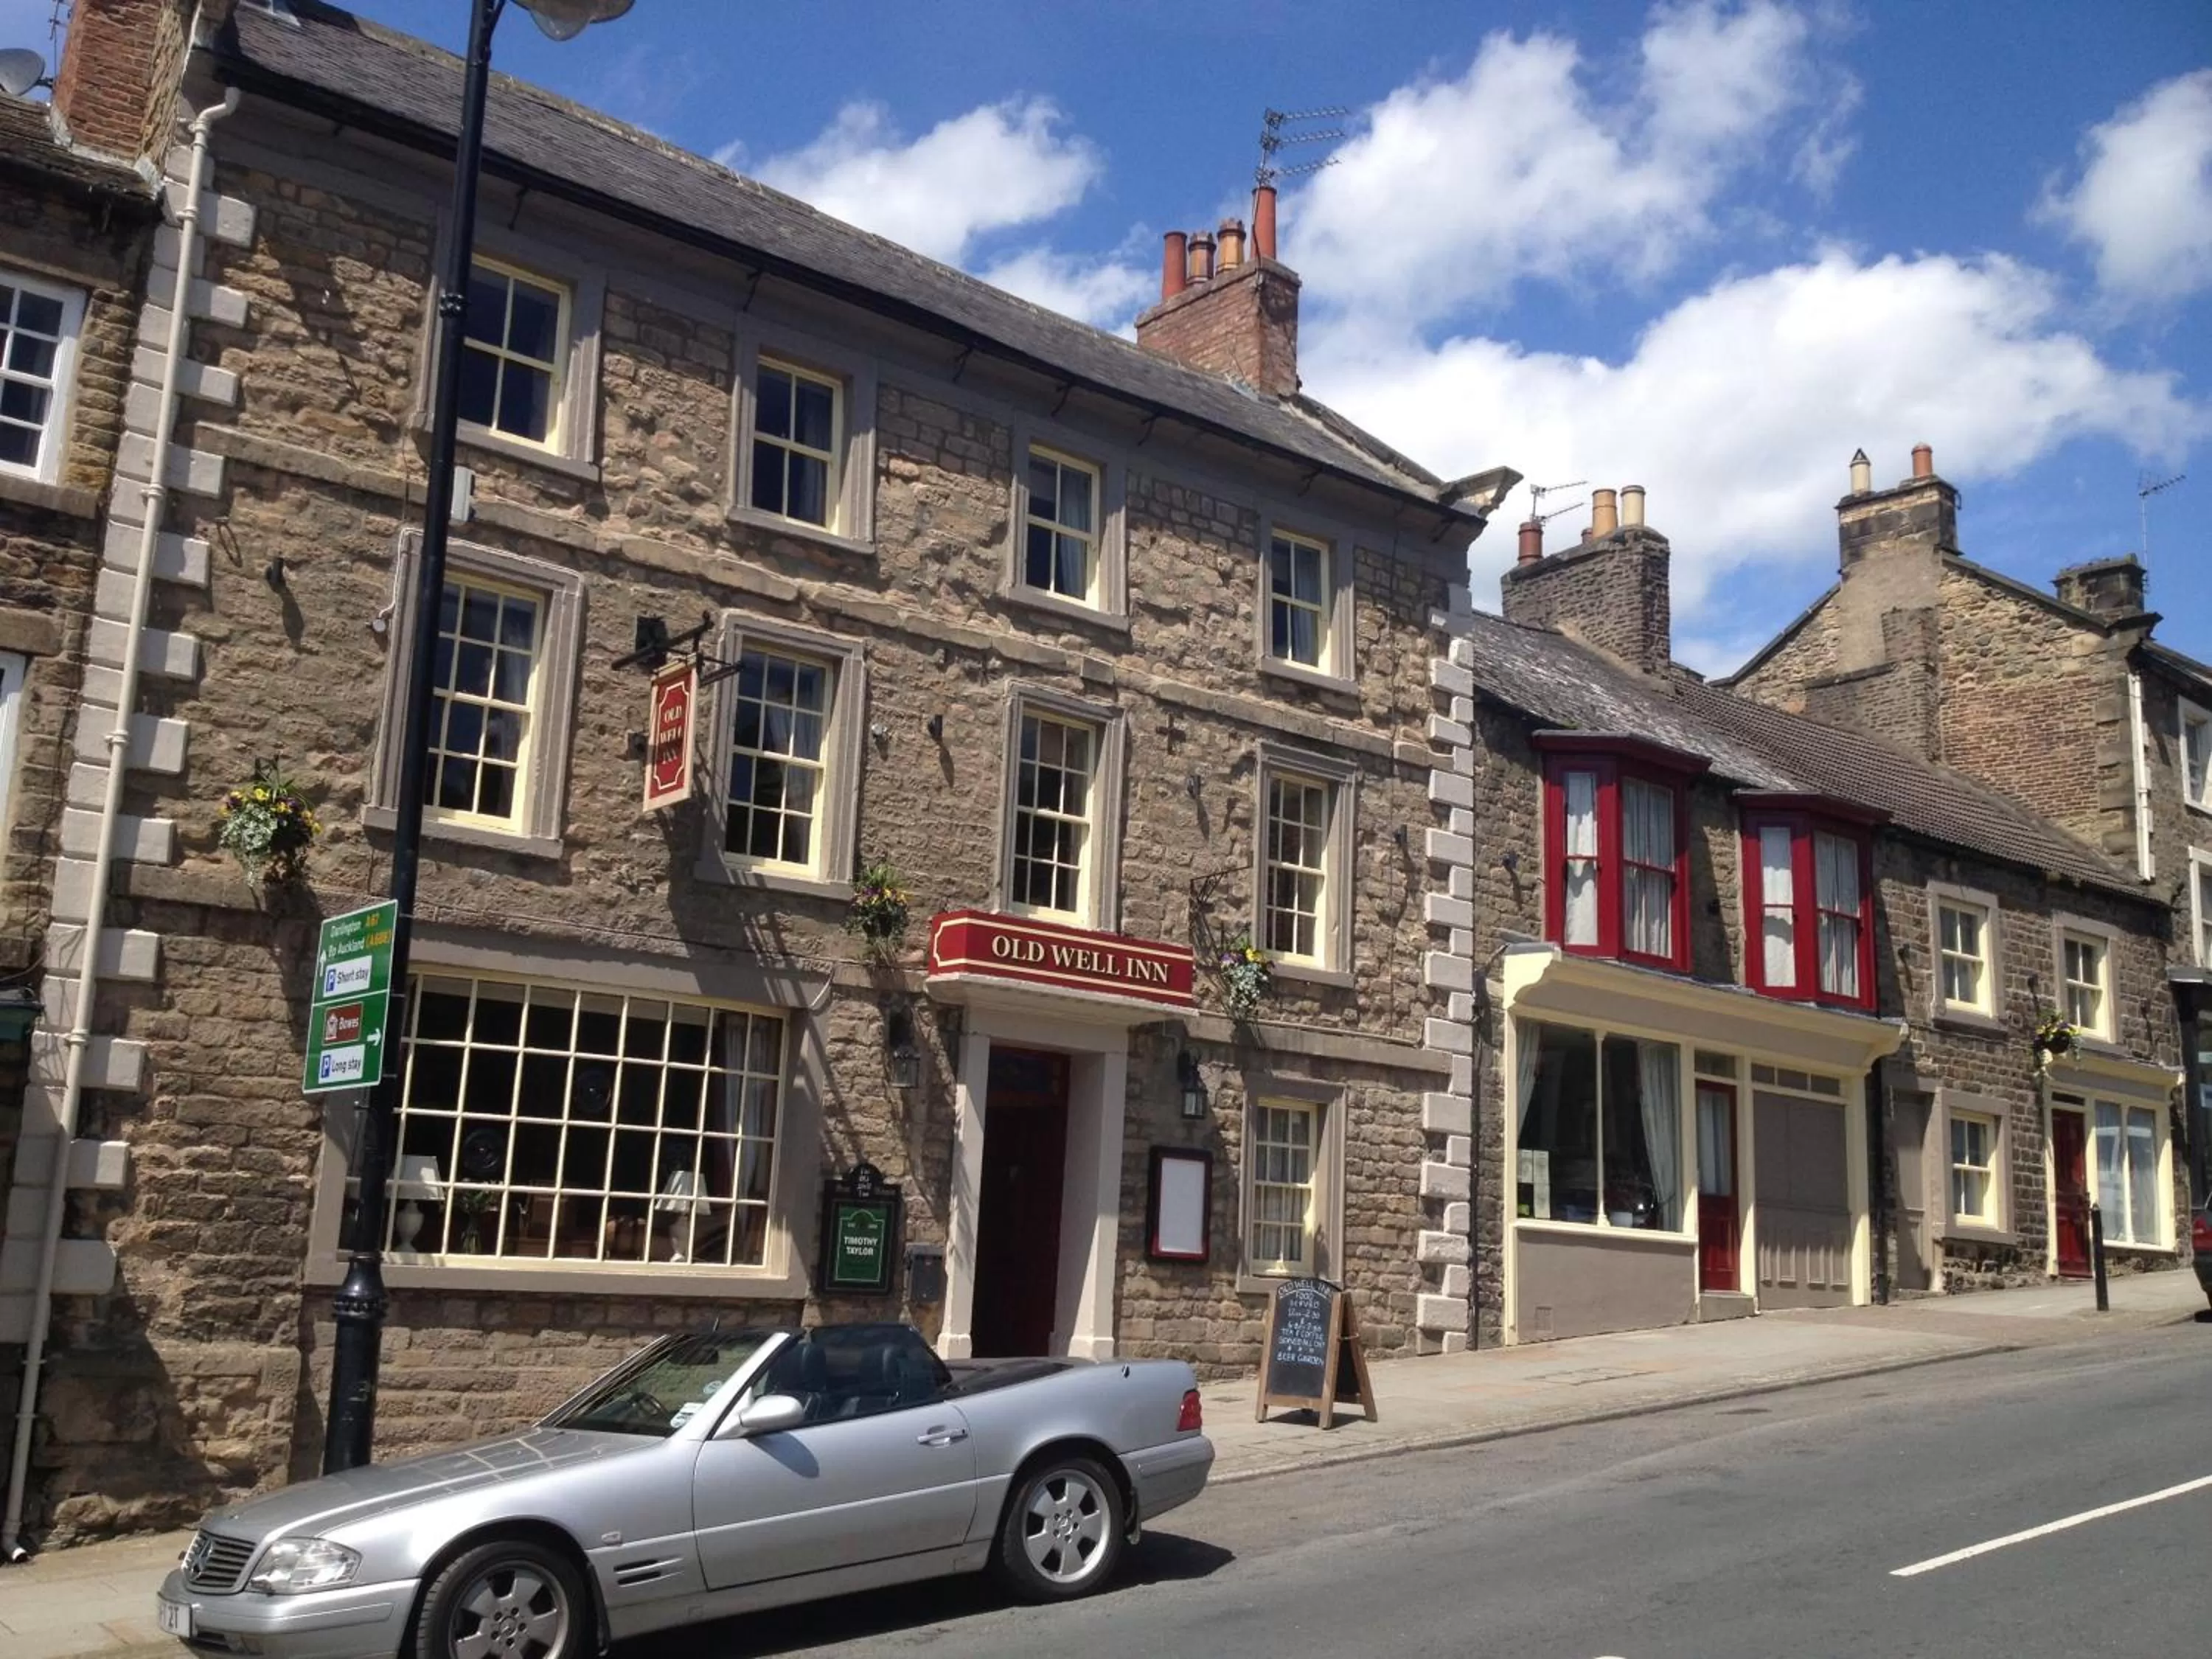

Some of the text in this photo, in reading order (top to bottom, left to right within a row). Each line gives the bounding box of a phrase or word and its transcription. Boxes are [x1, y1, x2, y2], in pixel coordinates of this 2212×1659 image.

[664, 705, 682, 723] OLD
[330, 920, 362, 938] Darlington
[337, 936, 365, 953] Auckland
[992, 934, 1169, 984] OLD WELL INN
[337, 968, 355, 984] Short
[355, 967, 369, 981] stay
[339, 1017, 360, 1030] Bowes
[332, 1060, 347, 1074] Long
[348, 1057, 361, 1071] stay
[844, 1236, 878, 1246] TIMOTHY
[846, 1246, 874, 1256] TAYLOR
[1278, 1281, 1294, 1296] OLD
[1294, 1279, 1313, 1289] WELL
